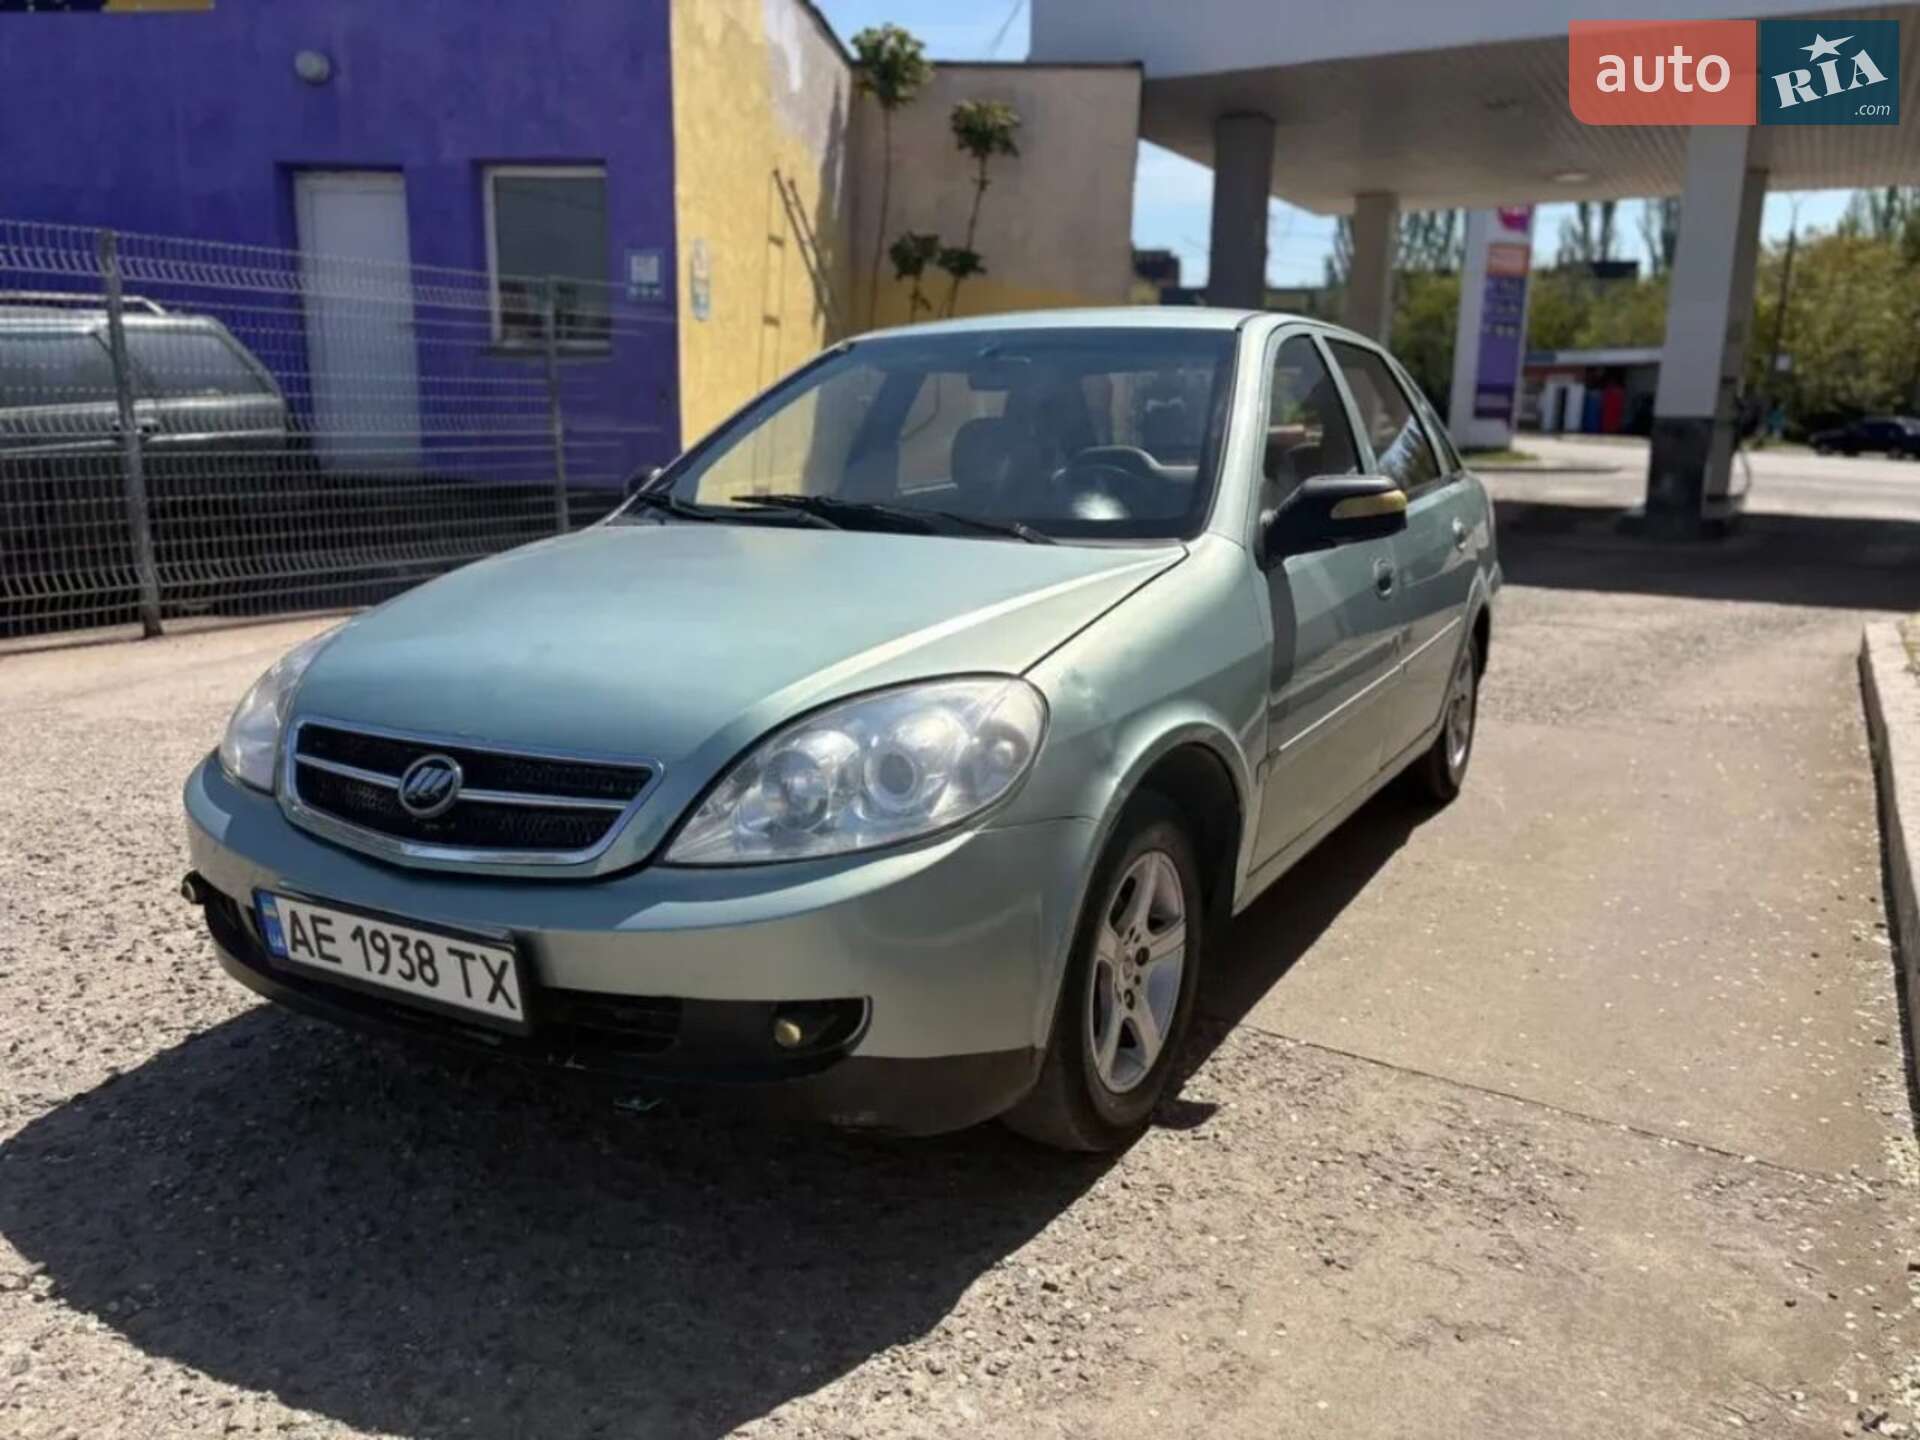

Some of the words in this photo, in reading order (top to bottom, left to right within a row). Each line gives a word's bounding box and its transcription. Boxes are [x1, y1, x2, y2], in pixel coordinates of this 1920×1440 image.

[289, 910, 342, 965] AE
[351, 924, 439, 988] 1938
[447, 946, 517, 1010] TX
